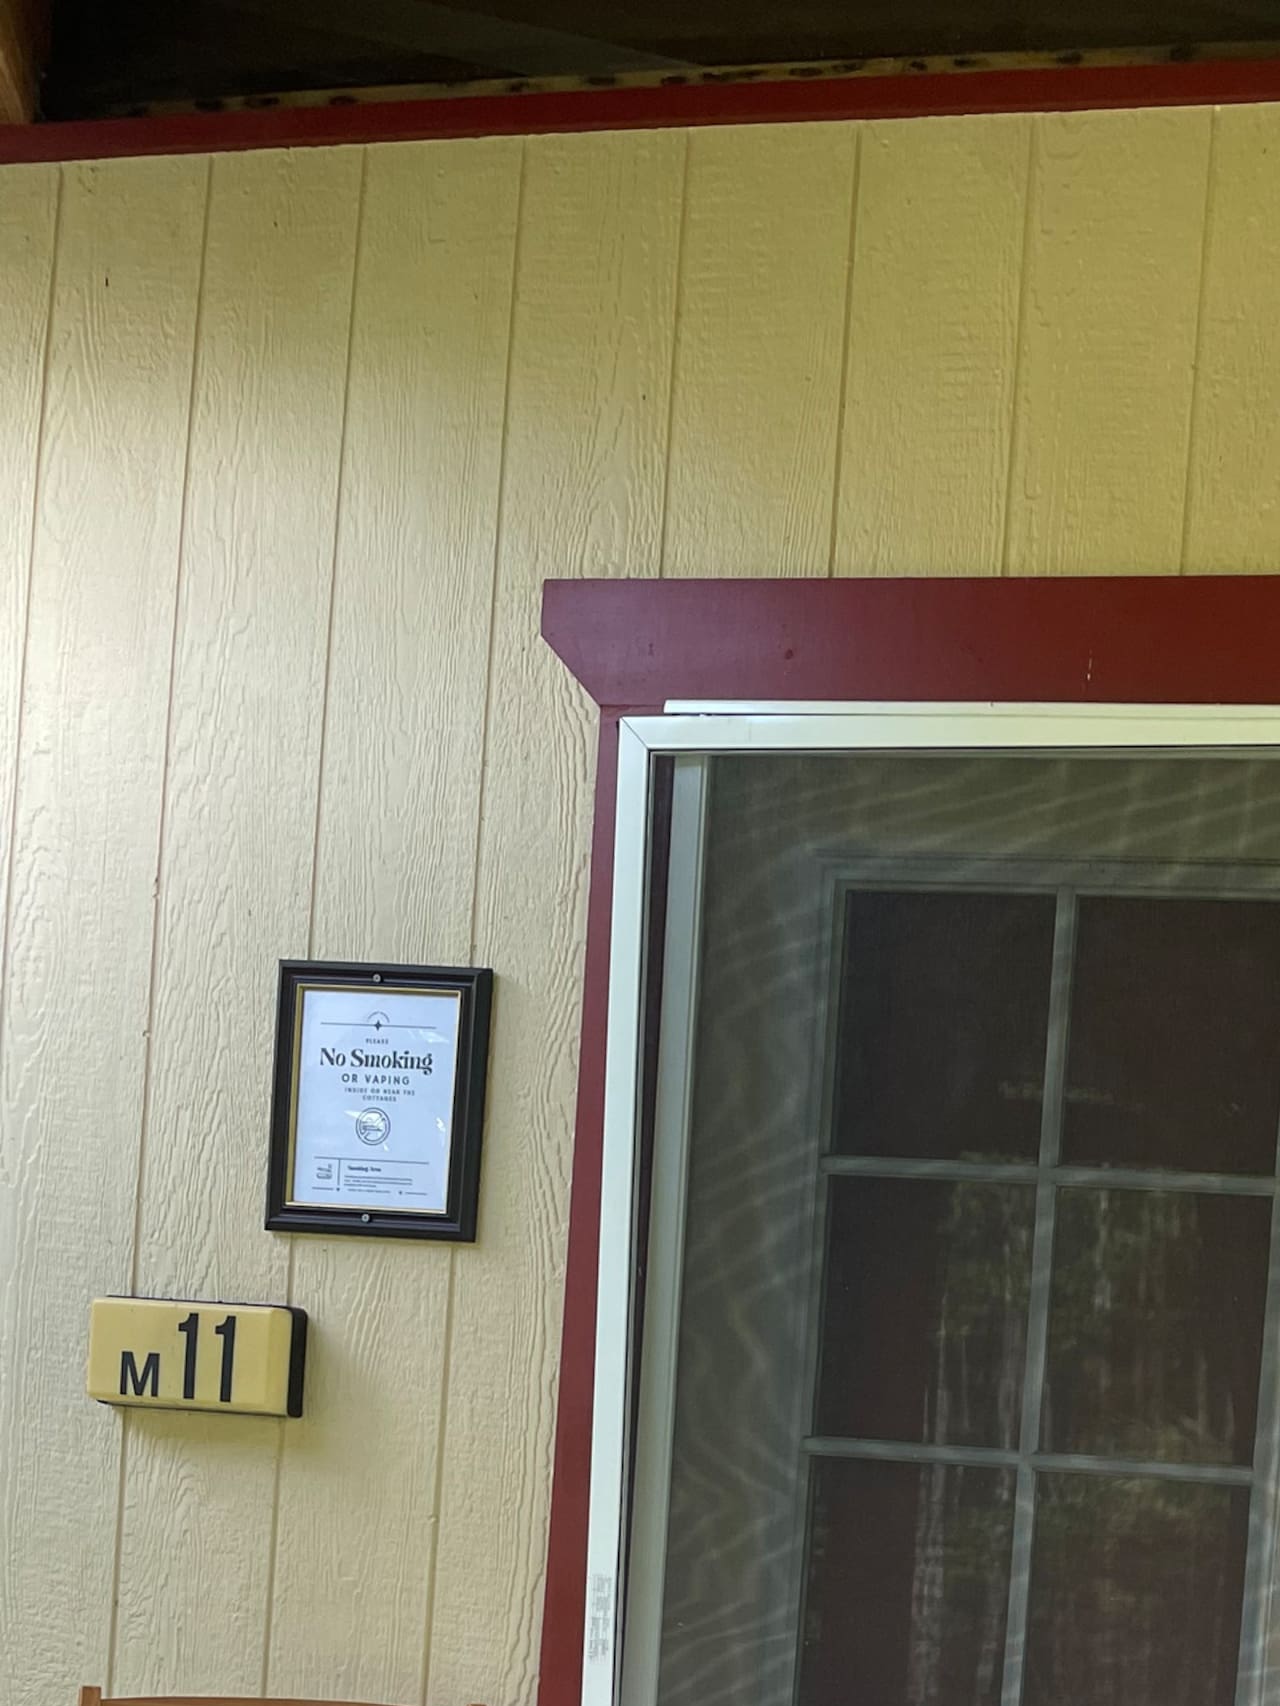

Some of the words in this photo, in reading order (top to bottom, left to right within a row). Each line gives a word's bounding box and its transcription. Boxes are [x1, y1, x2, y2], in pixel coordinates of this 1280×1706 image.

[320, 1047, 346, 1067] No
[350, 1048, 433, 1075] Smoking
[341, 1073, 358, 1083] OR
[365, 1074, 410, 1086] VAPING
